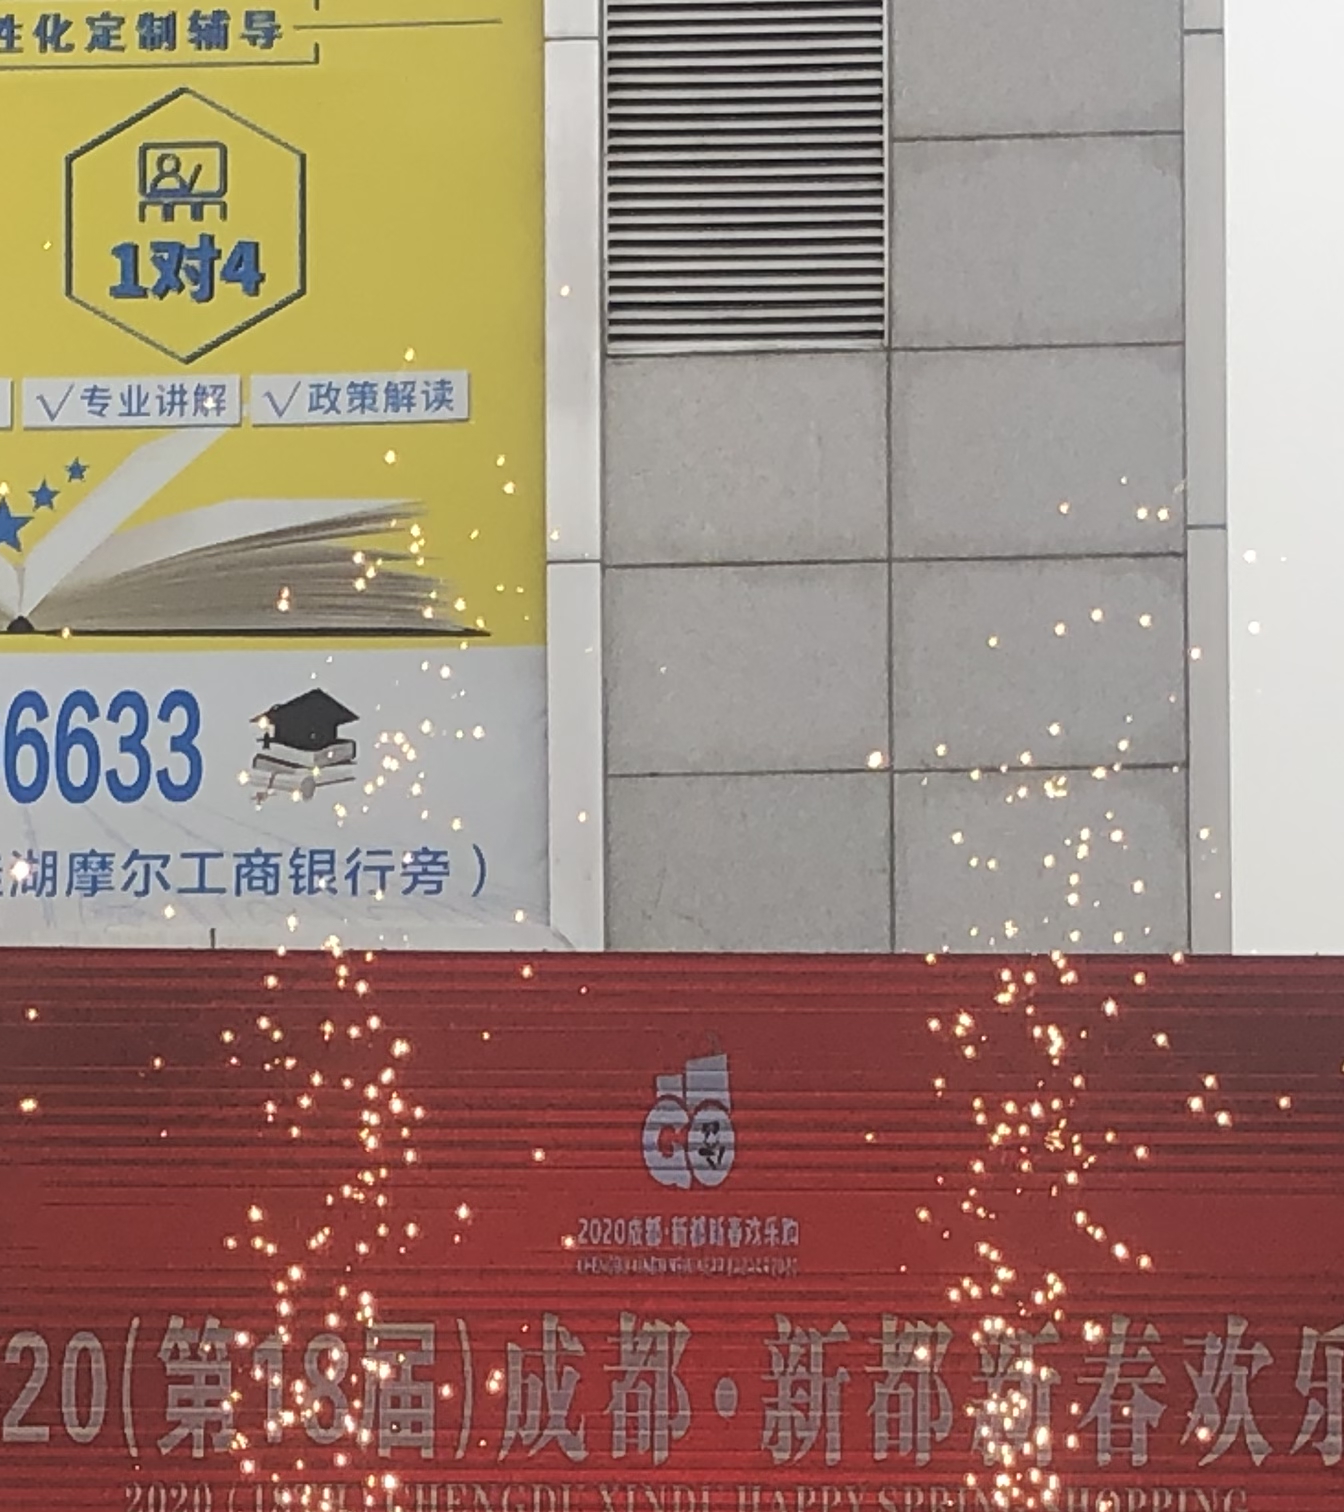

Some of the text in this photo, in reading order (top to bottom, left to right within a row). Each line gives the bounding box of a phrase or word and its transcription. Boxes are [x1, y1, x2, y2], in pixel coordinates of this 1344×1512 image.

[109, 233, 265, 306] 1对4
[80, 382, 227, 418] 专业讲解
[308, 378, 455, 413] 政策解读
